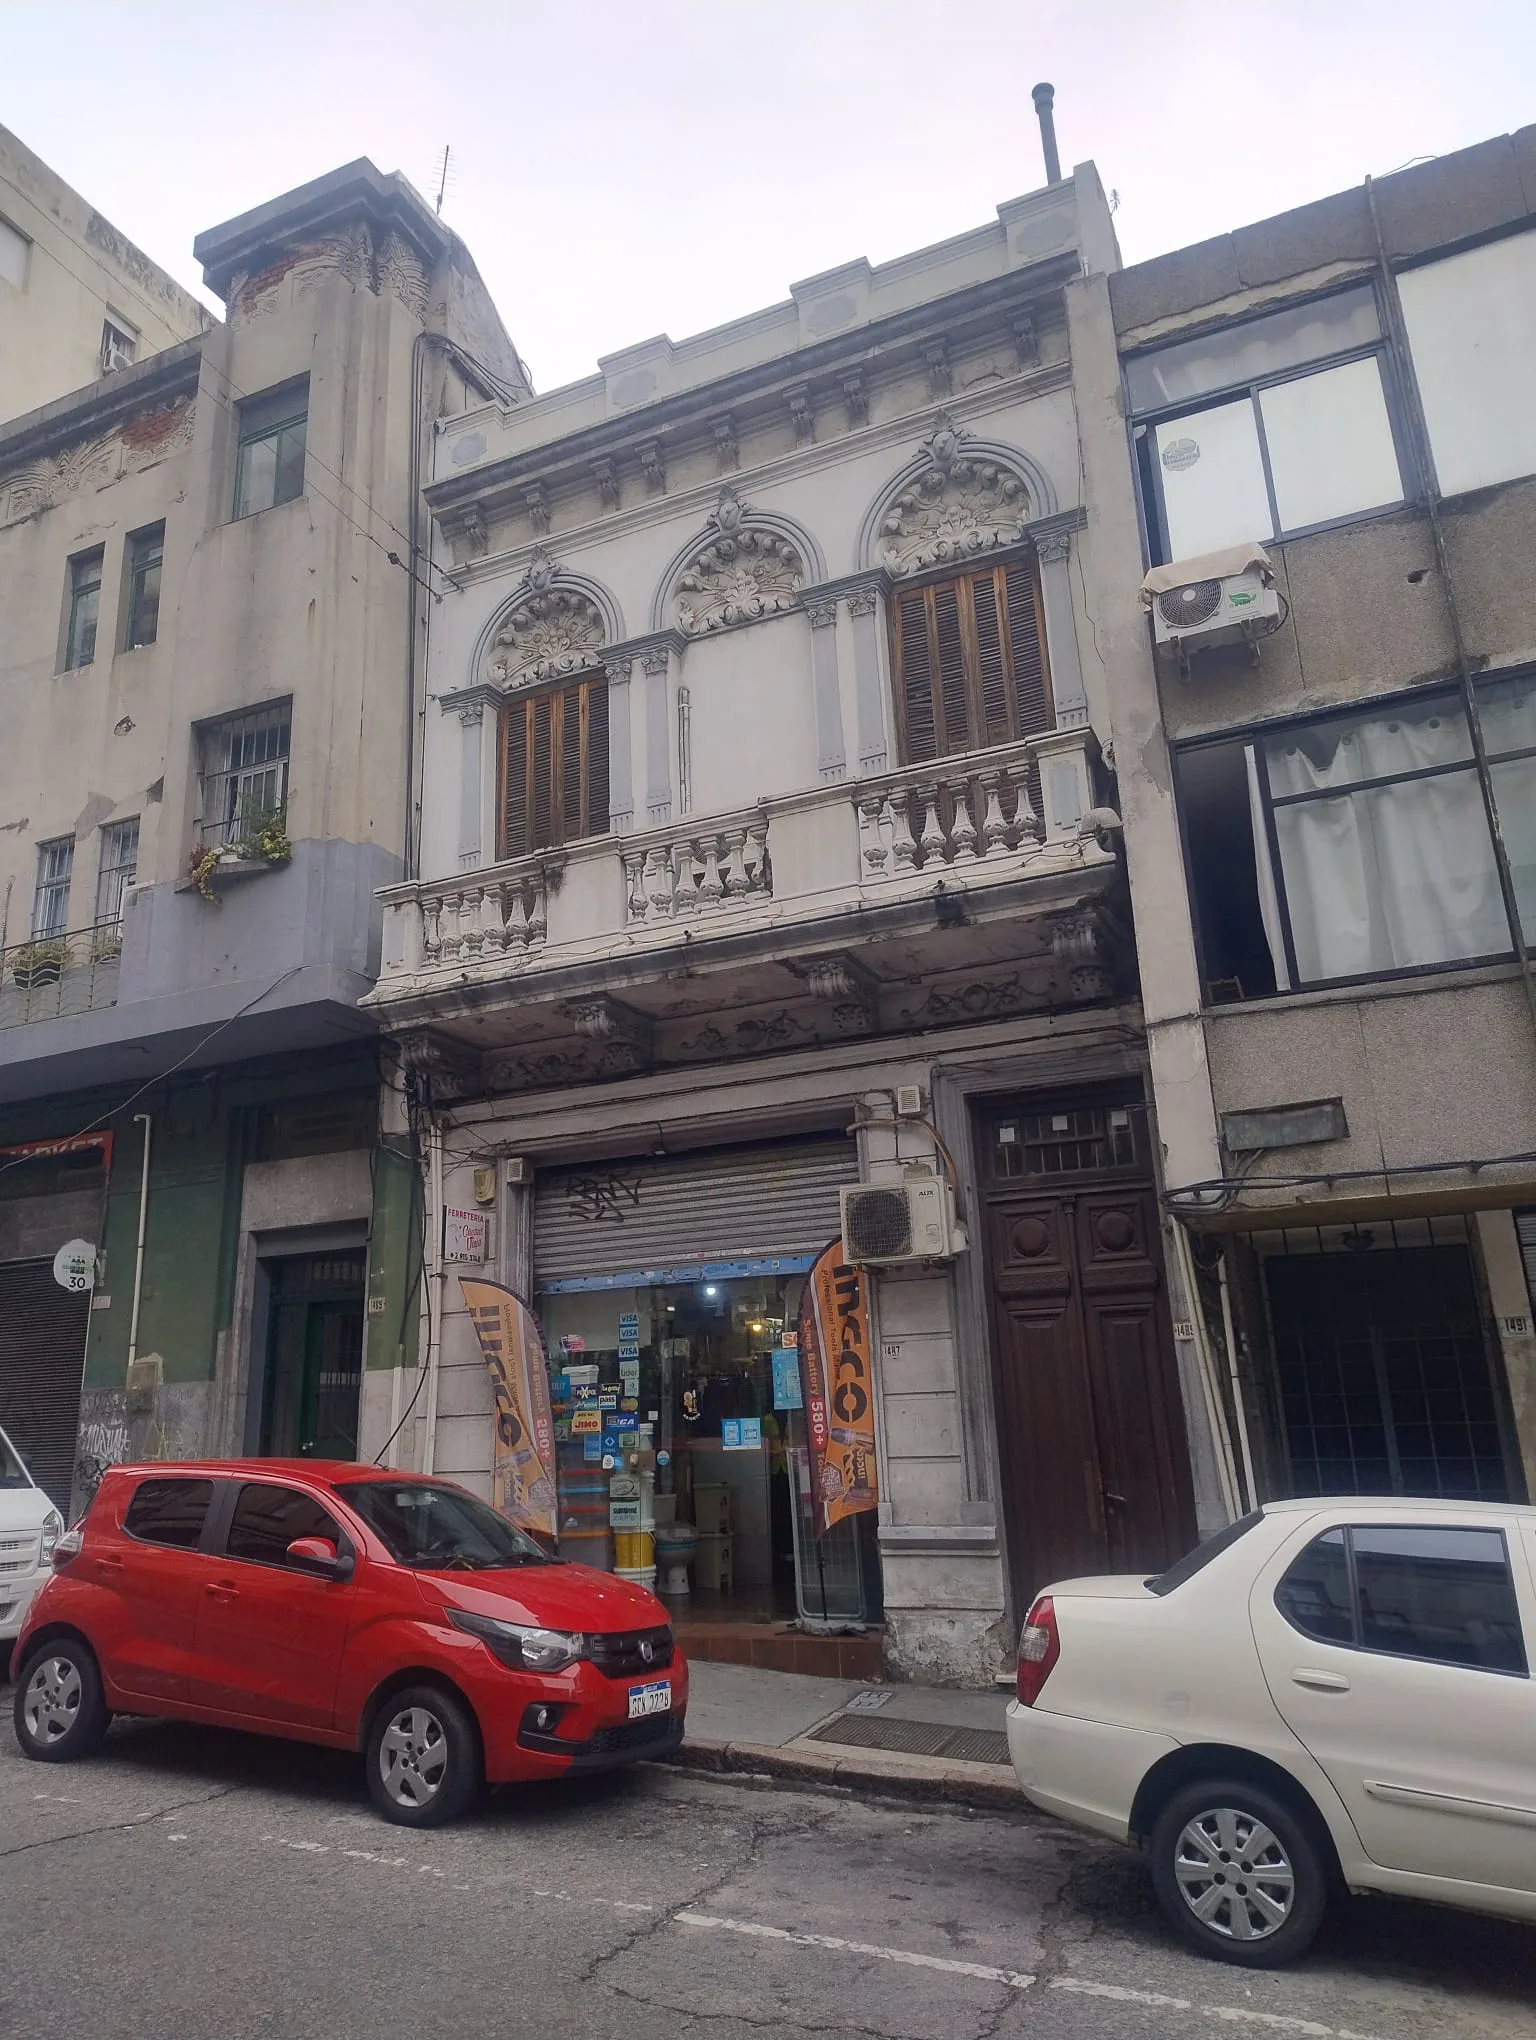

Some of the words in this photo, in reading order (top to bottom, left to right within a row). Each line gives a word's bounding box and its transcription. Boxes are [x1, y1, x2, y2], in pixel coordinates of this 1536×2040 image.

[448, 1209, 484, 1222] FERRETERIA
[69, 1277, 86, 1289] 30
[821, 1269, 836, 1325] Professional
[621, 1314, 638, 1323] VISA
[1504, 1317, 1528, 1331] 1491
[621, 1329, 638, 1338] VISA
[620, 1347, 638, 1356] VISA
[808, 1352, 820, 1395] Battery
[811, 1401, 825, 1446] 580+
